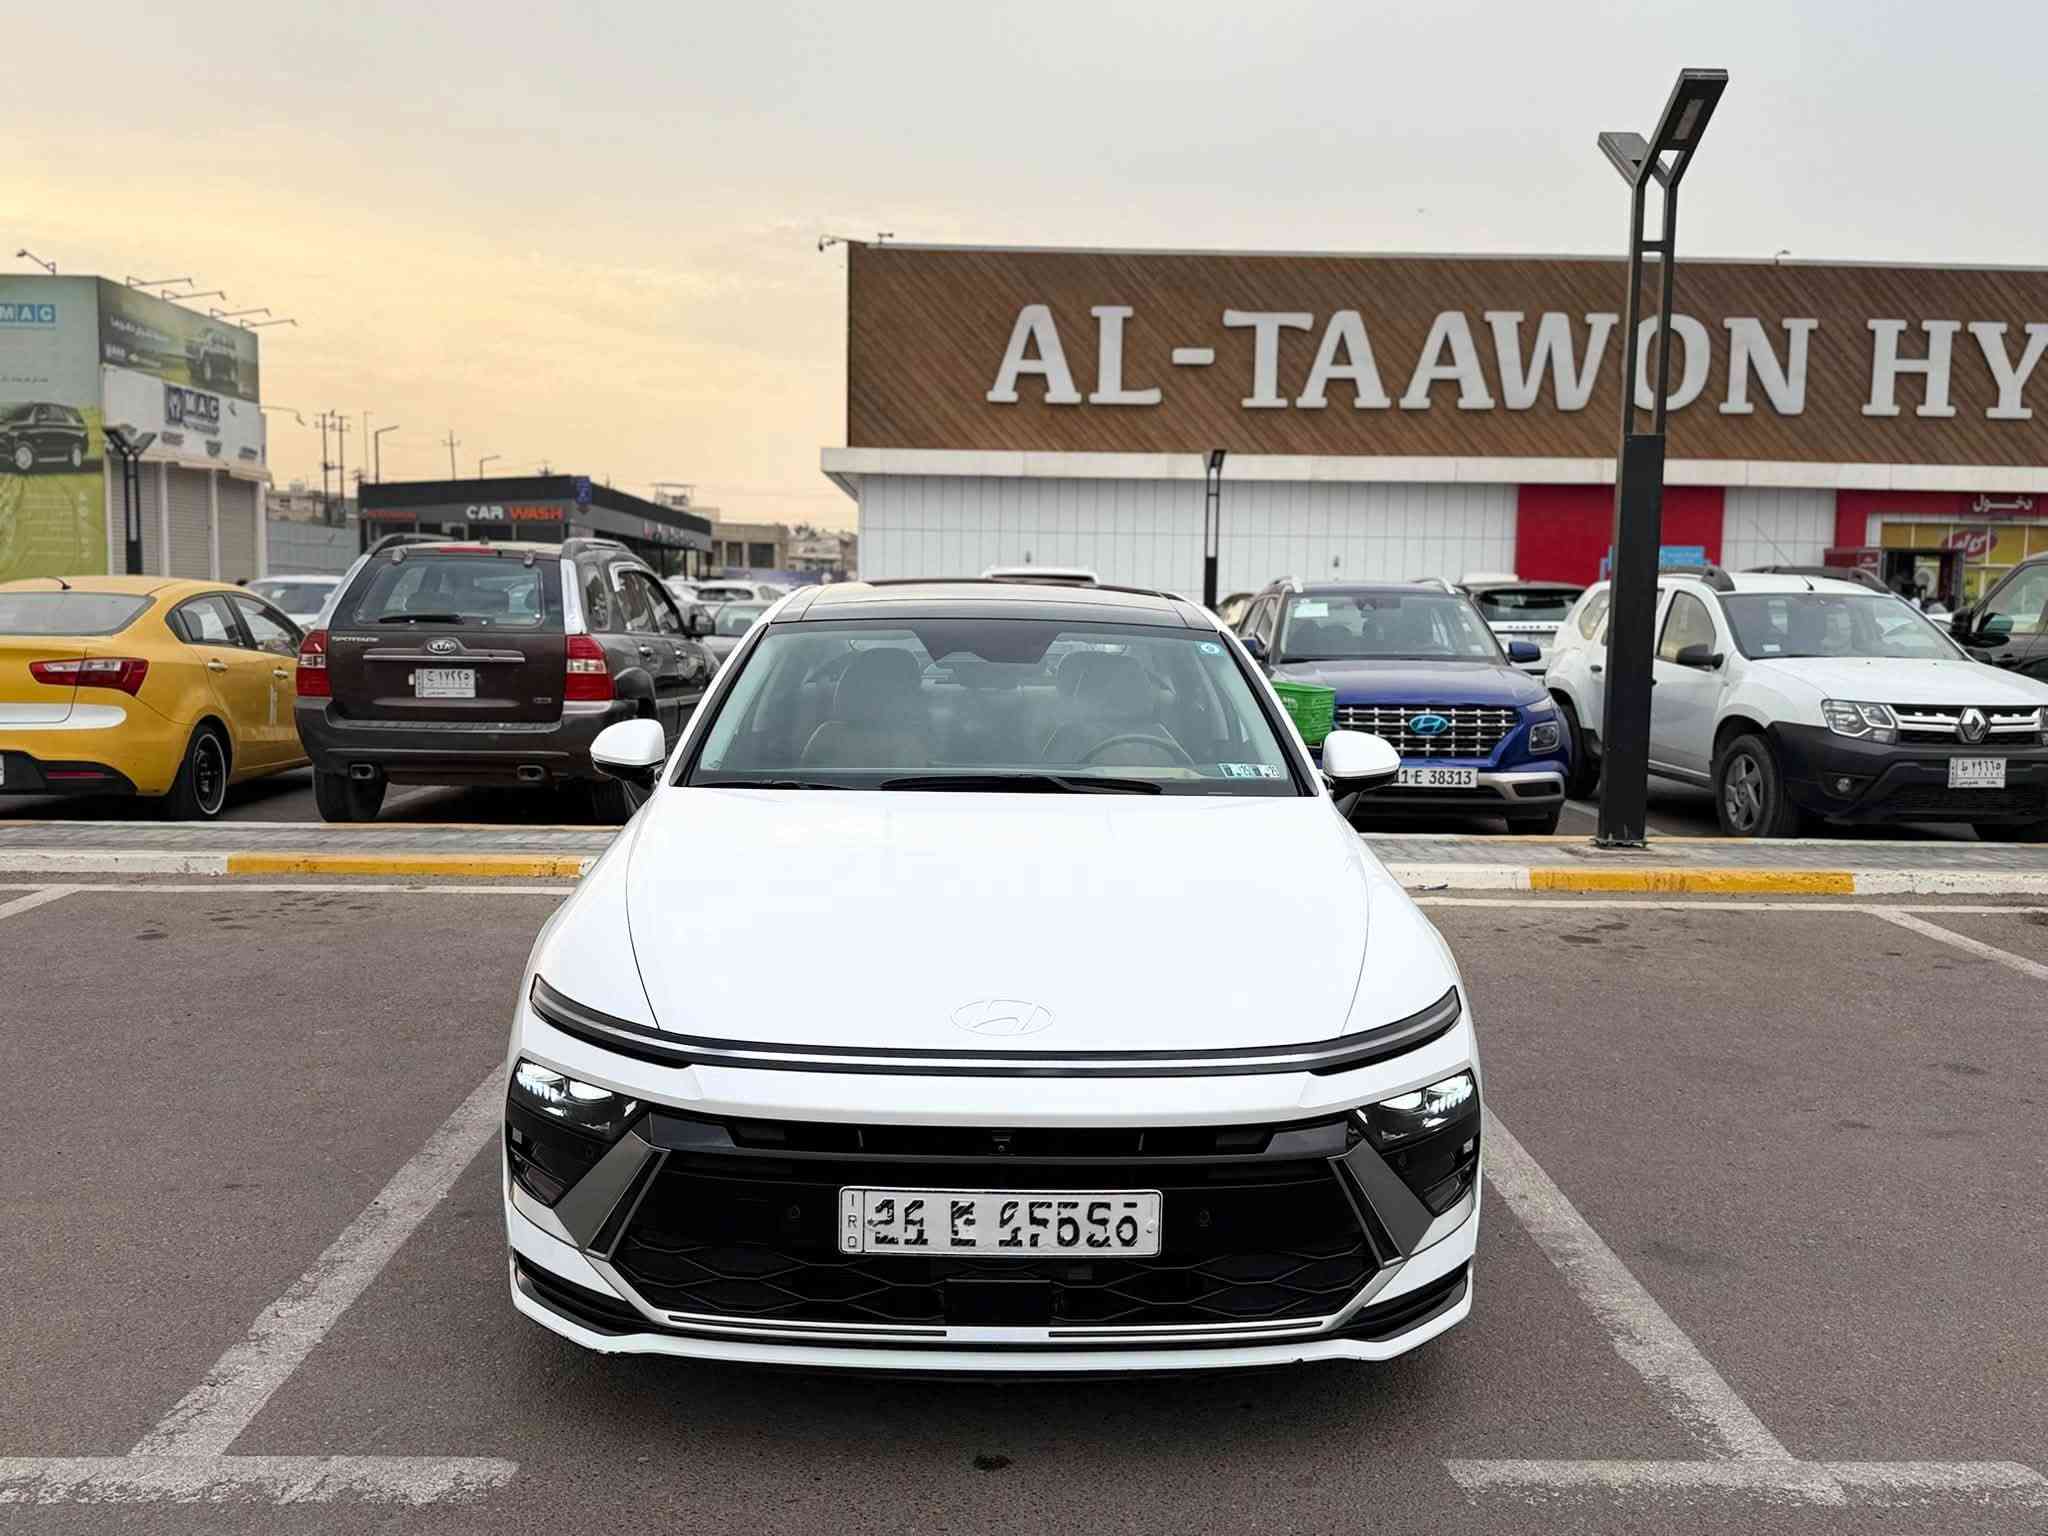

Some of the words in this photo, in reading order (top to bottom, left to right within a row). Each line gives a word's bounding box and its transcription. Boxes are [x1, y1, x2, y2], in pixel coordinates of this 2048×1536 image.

[1861, 319, 2048, 420] HY
[184, 392, 220, 420] MAC
[465, 505, 504, 520] CAR
[509, 505, 564, 521] WASH
[1972, 494, 2033, 513] دخول
[1414, 769, 1423, 785] E
[1428, 770, 1472, 785] 38313
